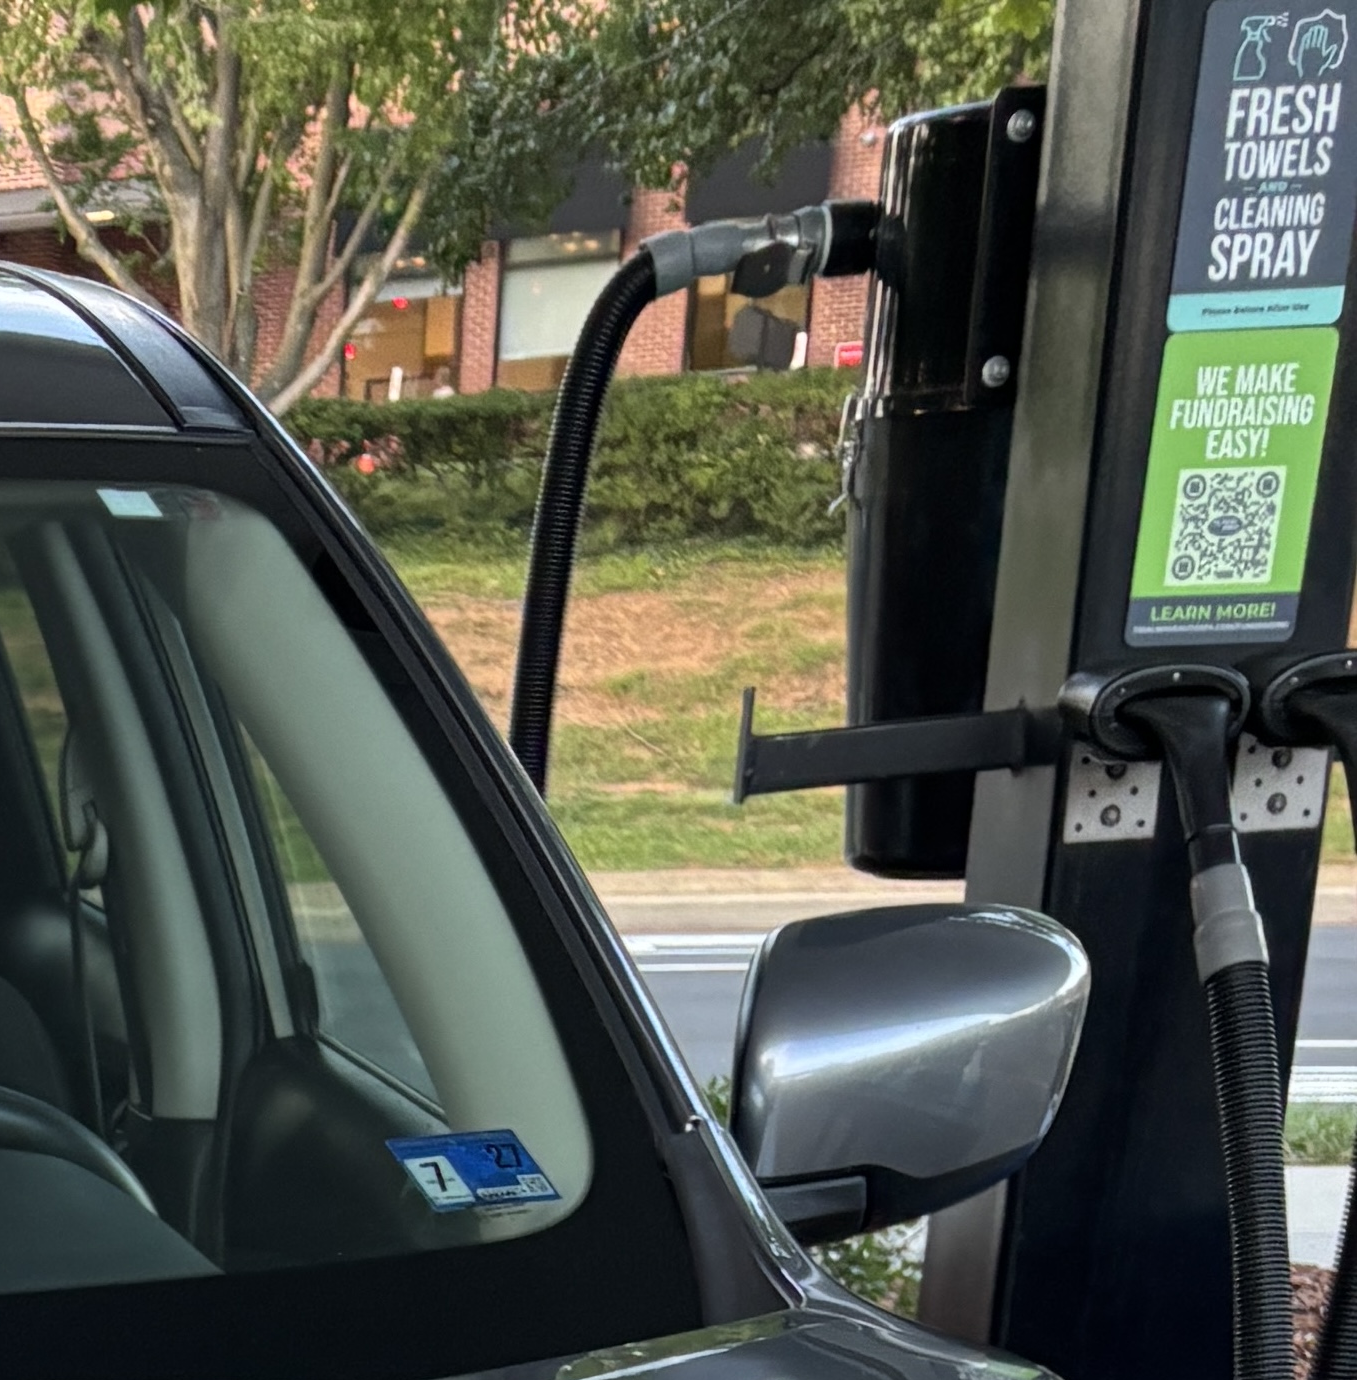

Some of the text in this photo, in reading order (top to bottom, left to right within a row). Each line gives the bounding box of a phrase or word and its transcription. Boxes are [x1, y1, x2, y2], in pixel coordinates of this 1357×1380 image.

[1226, 82, 1342, 138] FRESH
[1224, 136, 1334, 182] TOWELS
[1258, 181, 1288, 194] AND
[1214, 192, 1325, 231] CLEANING
[1208, 229, 1321, 282] SPRAY
[1197, 362, 1299, 396] WE MAKE
[1170, 394, 1315, 430] FUNDRAISING
[1204, 427, 1270, 460] EASY!
[1150, 602, 1277, 622] LEARN MORE!
[419, 1161, 447, 1192] 7
